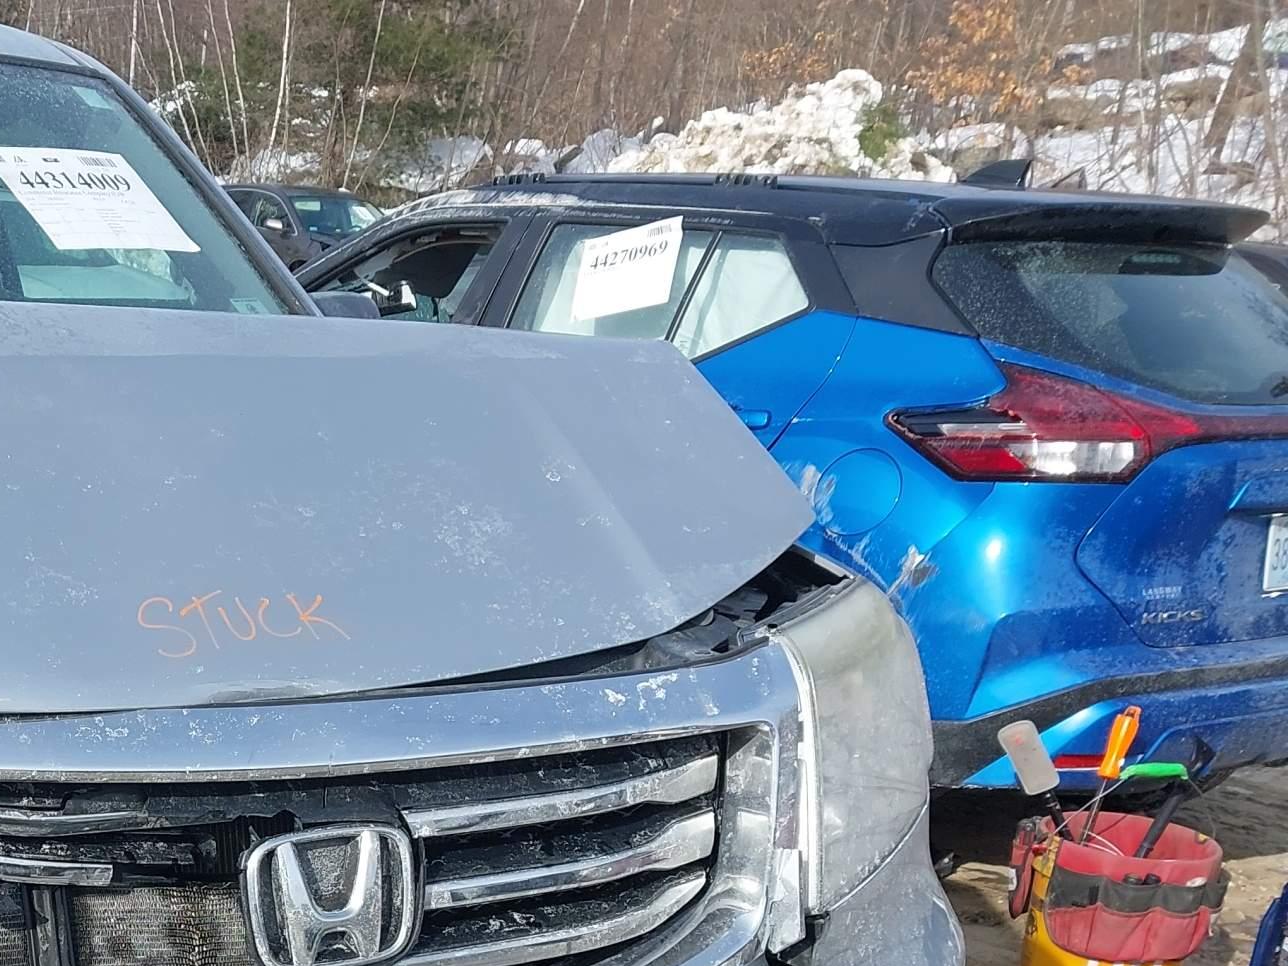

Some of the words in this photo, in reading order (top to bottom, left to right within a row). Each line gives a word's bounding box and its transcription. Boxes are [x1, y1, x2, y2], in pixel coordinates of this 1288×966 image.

[19, 170, 131, 192] 44314009
[589, 239, 669, 270] 44270969
[137, 590, 351, 657] STUCK
[1141, 608, 1204, 625] KICKS
